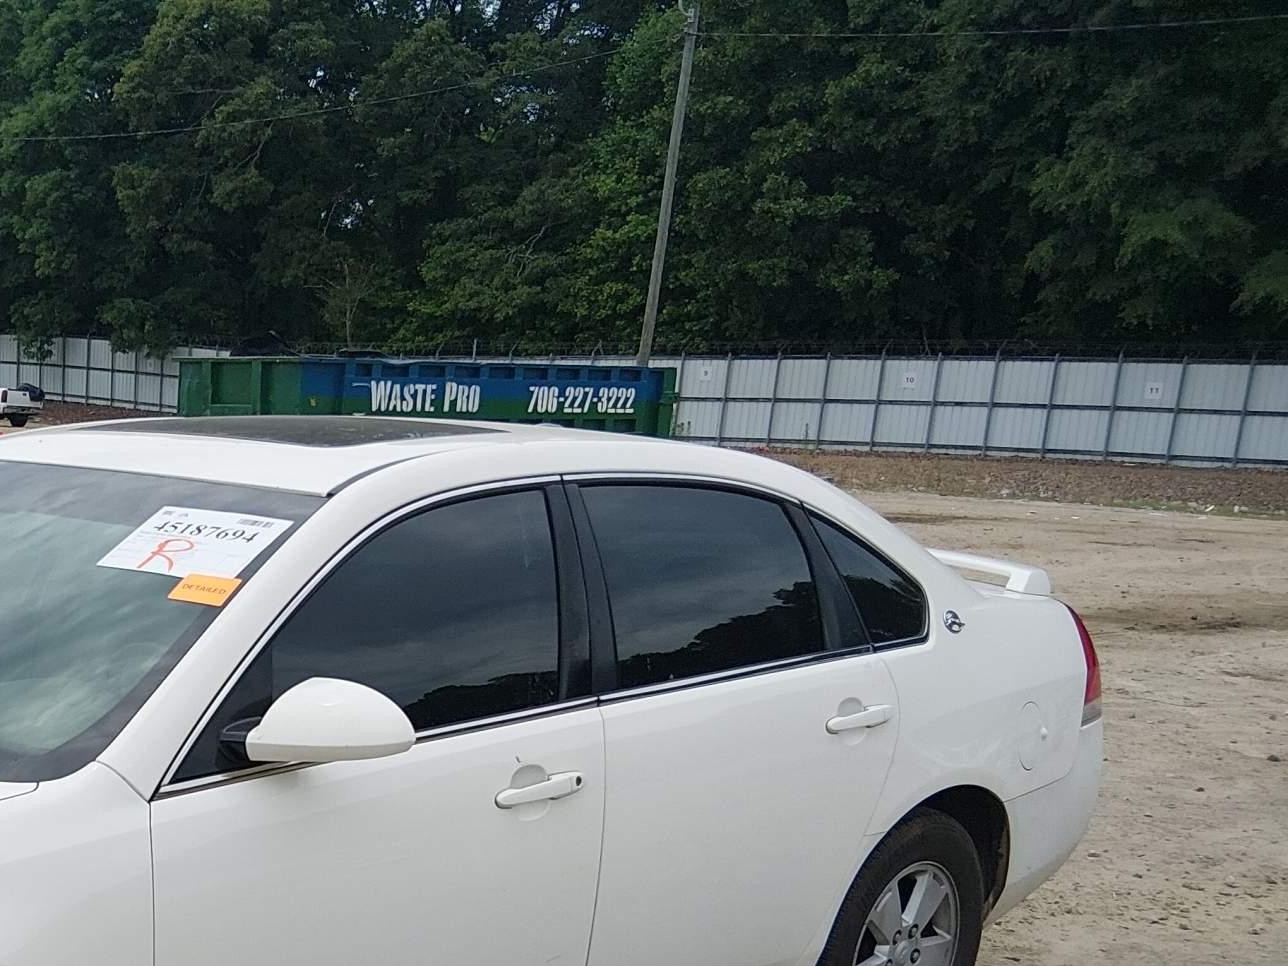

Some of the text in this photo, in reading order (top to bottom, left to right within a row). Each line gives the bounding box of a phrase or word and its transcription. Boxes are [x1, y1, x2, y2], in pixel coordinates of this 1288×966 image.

[370, 380, 480, 413] WASTE PRO
[527, 386, 636, 414] 706-227-3222
[154, 520, 260, 543] 45187694
